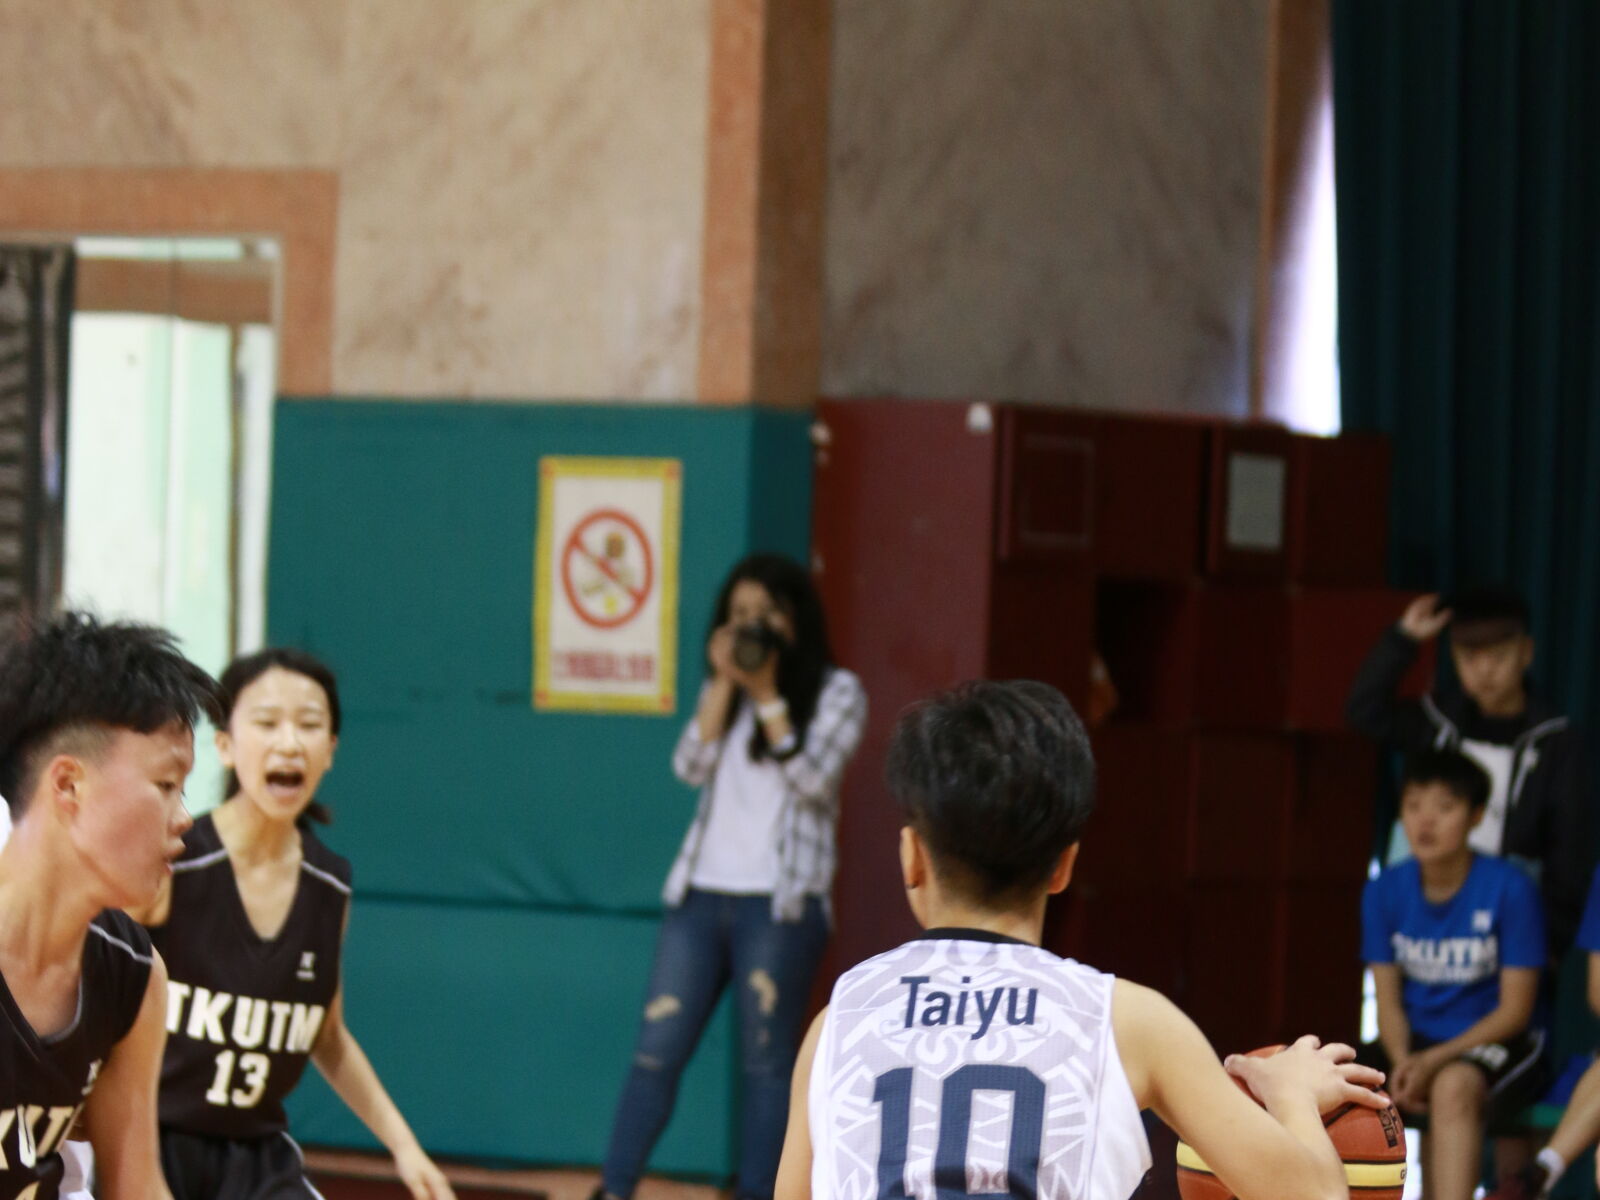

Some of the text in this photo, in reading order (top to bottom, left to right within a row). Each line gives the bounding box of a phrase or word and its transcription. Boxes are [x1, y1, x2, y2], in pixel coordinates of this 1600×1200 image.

[165, 979, 325, 1053] TKUTM
[899, 975, 1039, 1041] Taiyu
[206, 1049, 271, 1108] 13
